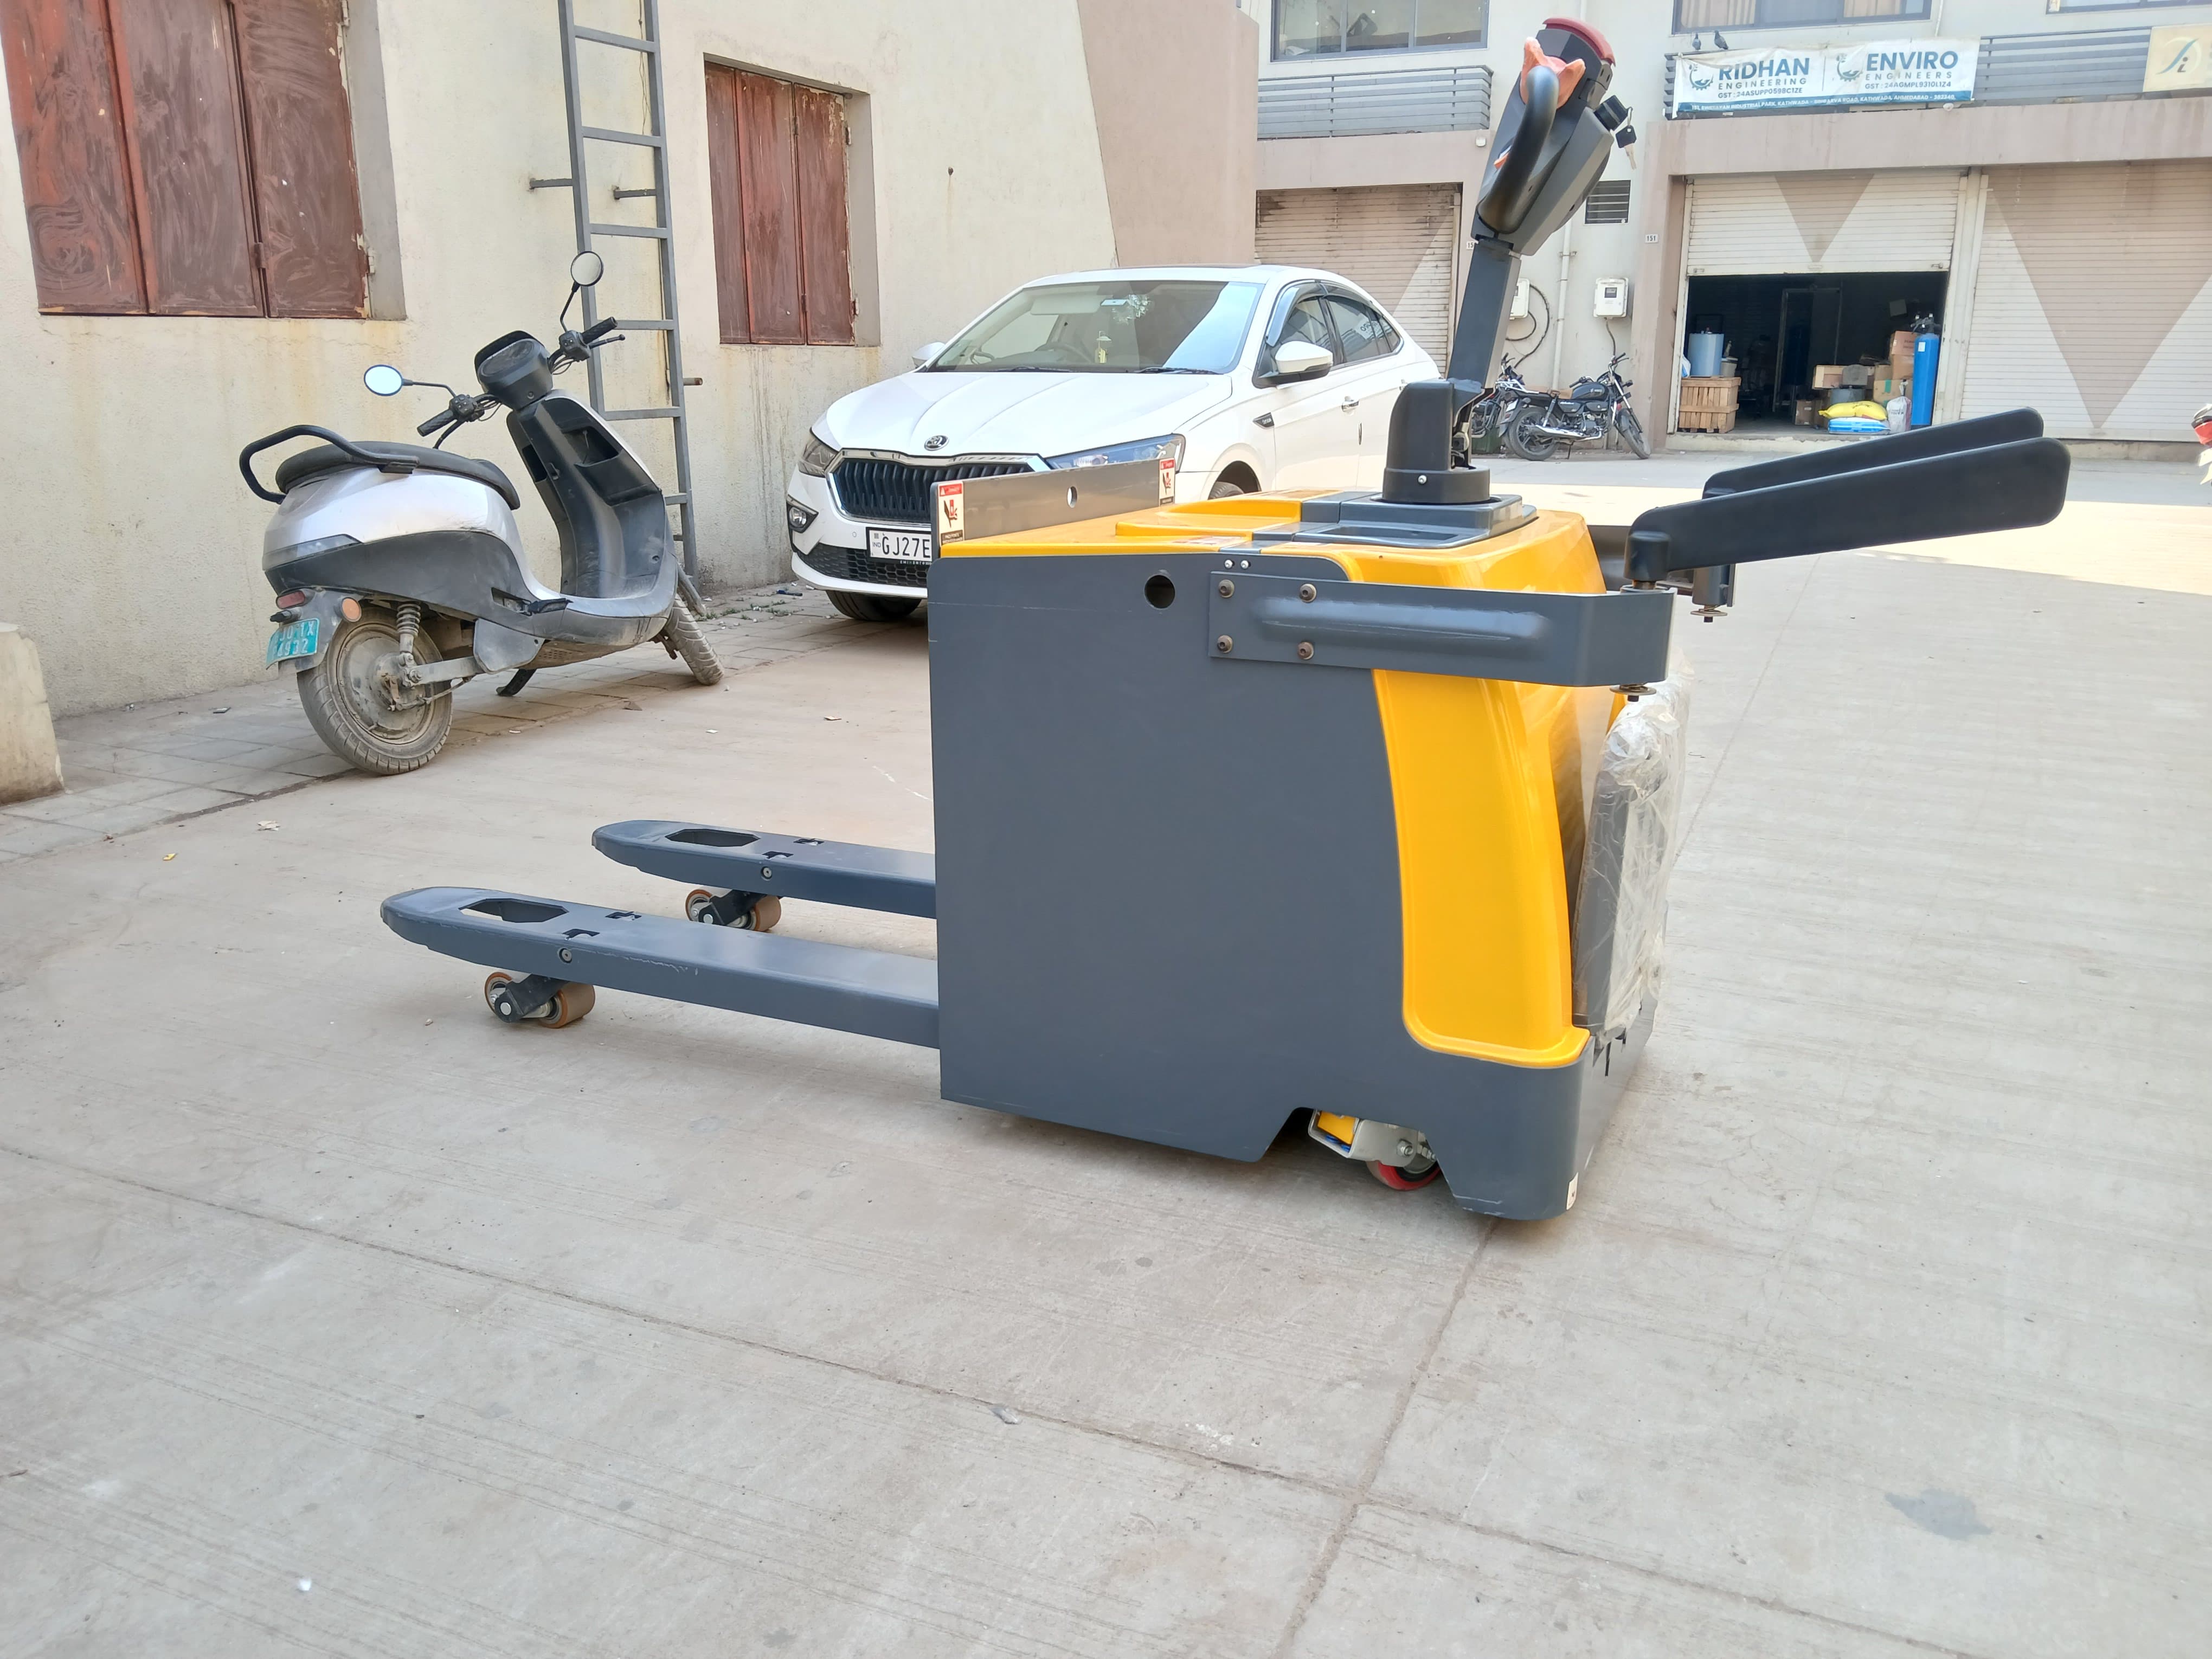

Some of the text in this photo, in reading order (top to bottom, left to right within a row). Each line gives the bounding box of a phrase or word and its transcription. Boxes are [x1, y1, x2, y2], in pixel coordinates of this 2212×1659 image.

[1719, 57, 1810, 80] RIDHAN
[1866, 51, 1958, 71] ENVIRO
[1718, 78, 1807, 90] ENGINEERING
[1865, 72, 1952, 80] ENGINEERS
